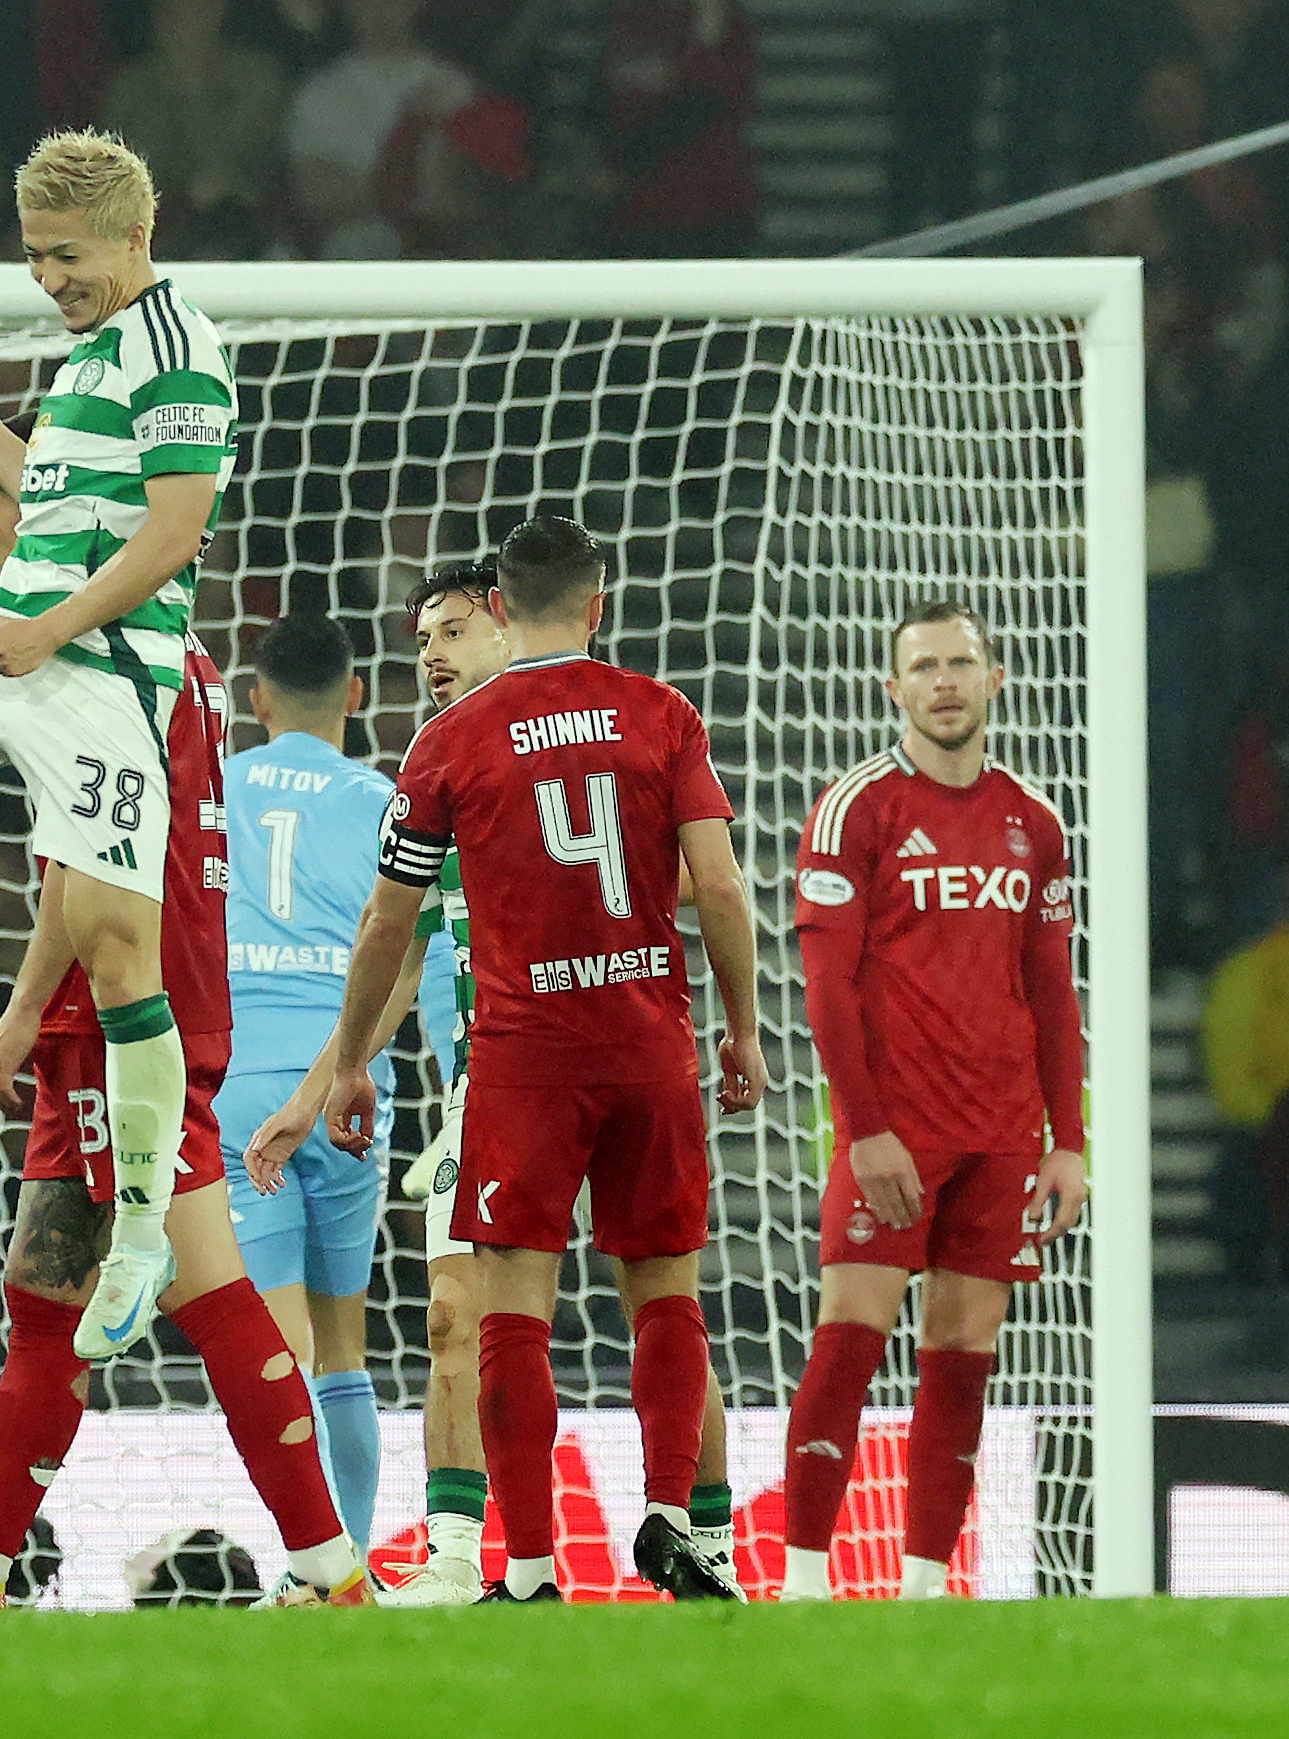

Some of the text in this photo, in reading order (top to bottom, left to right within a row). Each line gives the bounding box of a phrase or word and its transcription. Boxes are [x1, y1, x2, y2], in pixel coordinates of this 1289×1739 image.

[155, 406, 205, 424] CELTIC FC
[155, 424, 222, 443] FOUNDATION
[509, 708, 622, 755] SHINNIE
[71, 754, 144, 832] 38
[246, 763, 333, 795] MITOV
[257, 809, 299, 920] 1
[534, 772, 632, 918] 4
[900, 865, 1031, 913] TEXO
[246, 943, 351, 975] WASTE
[529, 945, 670, 993] EIS WASTE
